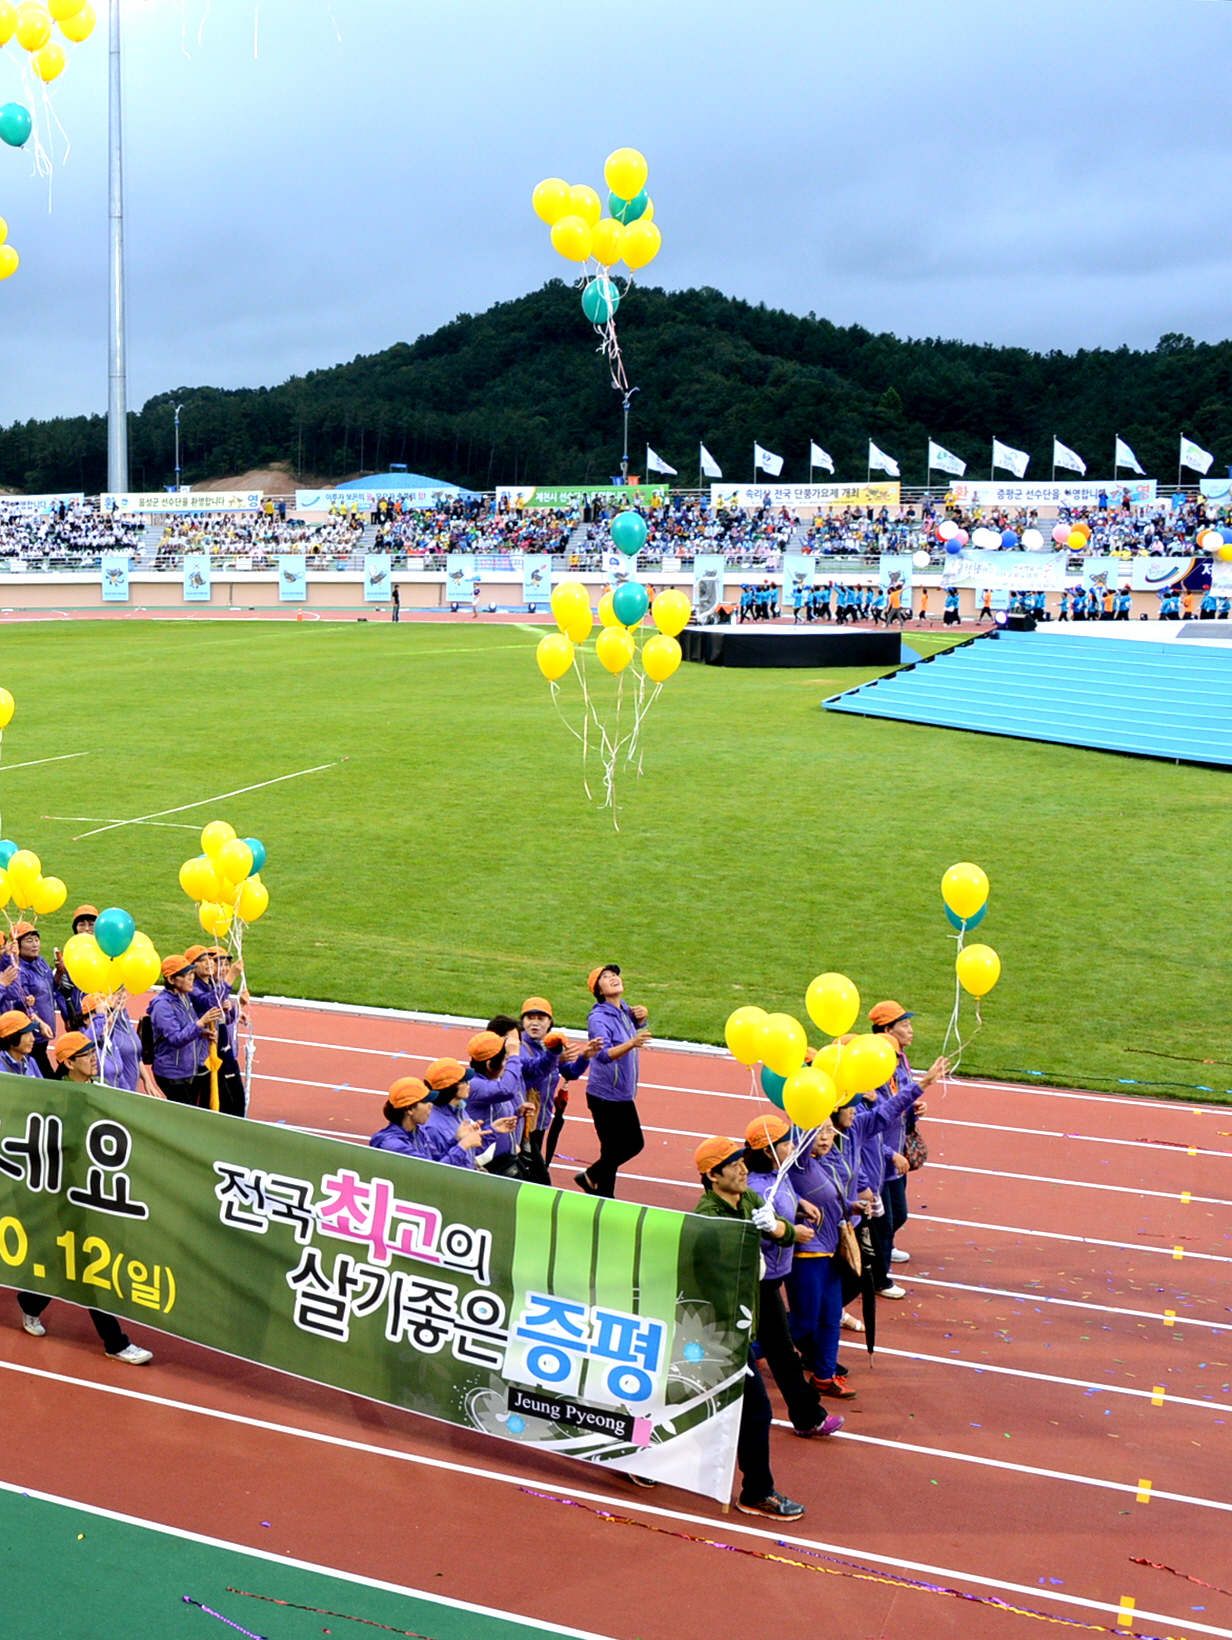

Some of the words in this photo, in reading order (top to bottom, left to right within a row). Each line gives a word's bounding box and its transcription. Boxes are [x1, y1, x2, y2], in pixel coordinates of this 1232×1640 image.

[535, 491, 558, 503] 제천시
[774, 488, 791, 500] 전국
[794, 487, 839, 500] 단풍가요제
[841, 487, 860, 499] 개최
[955, 485, 969, 501] 환
[996, 488, 1023, 501] 증평군
[1025, 488, 1060, 500] 선수단을
[1064, 488, 1106, 501] 영합니
[1135, 484, 1150, 500] 영
[138, 498, 159, 508] 음성군
[161, 497, 188, 508] 선수단을
[191, 496, 225, 507] 환영합니다
[247, 494, 258, 508] 영
[213, 1160, 315, 1244] 전국
[316, 1168, 492, 1286] 최고의
[515, 1290, 668, 1406] 증평
[513, 1392, 562, 1422] Jeung
[564, 1403, 627, 1436] Pyeong
